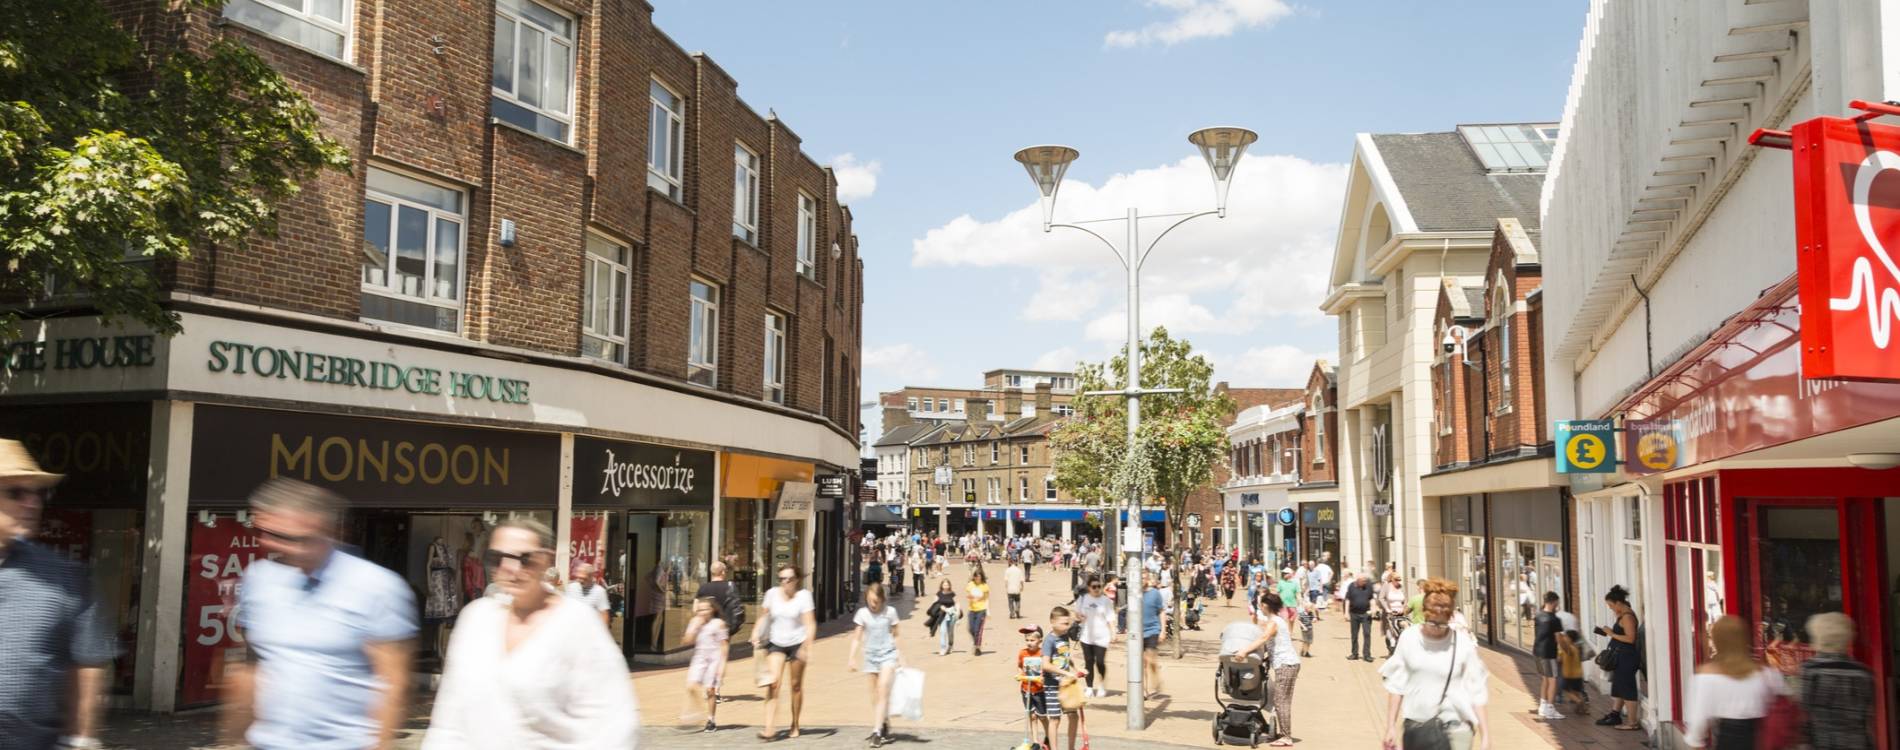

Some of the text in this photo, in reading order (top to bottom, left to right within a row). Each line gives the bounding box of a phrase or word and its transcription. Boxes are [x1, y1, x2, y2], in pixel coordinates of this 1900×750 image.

[54, 335, 156, 370] HOUSE
[207, 340, 530, 404] STONEBRIDGE HOUSE
[1558, 423, 1610, 431] Poundland
[269, 433, 510, 486] MONSOON
[600, 449, 695, 497] Accessorize
[569, 540, 605, 557] SALE
